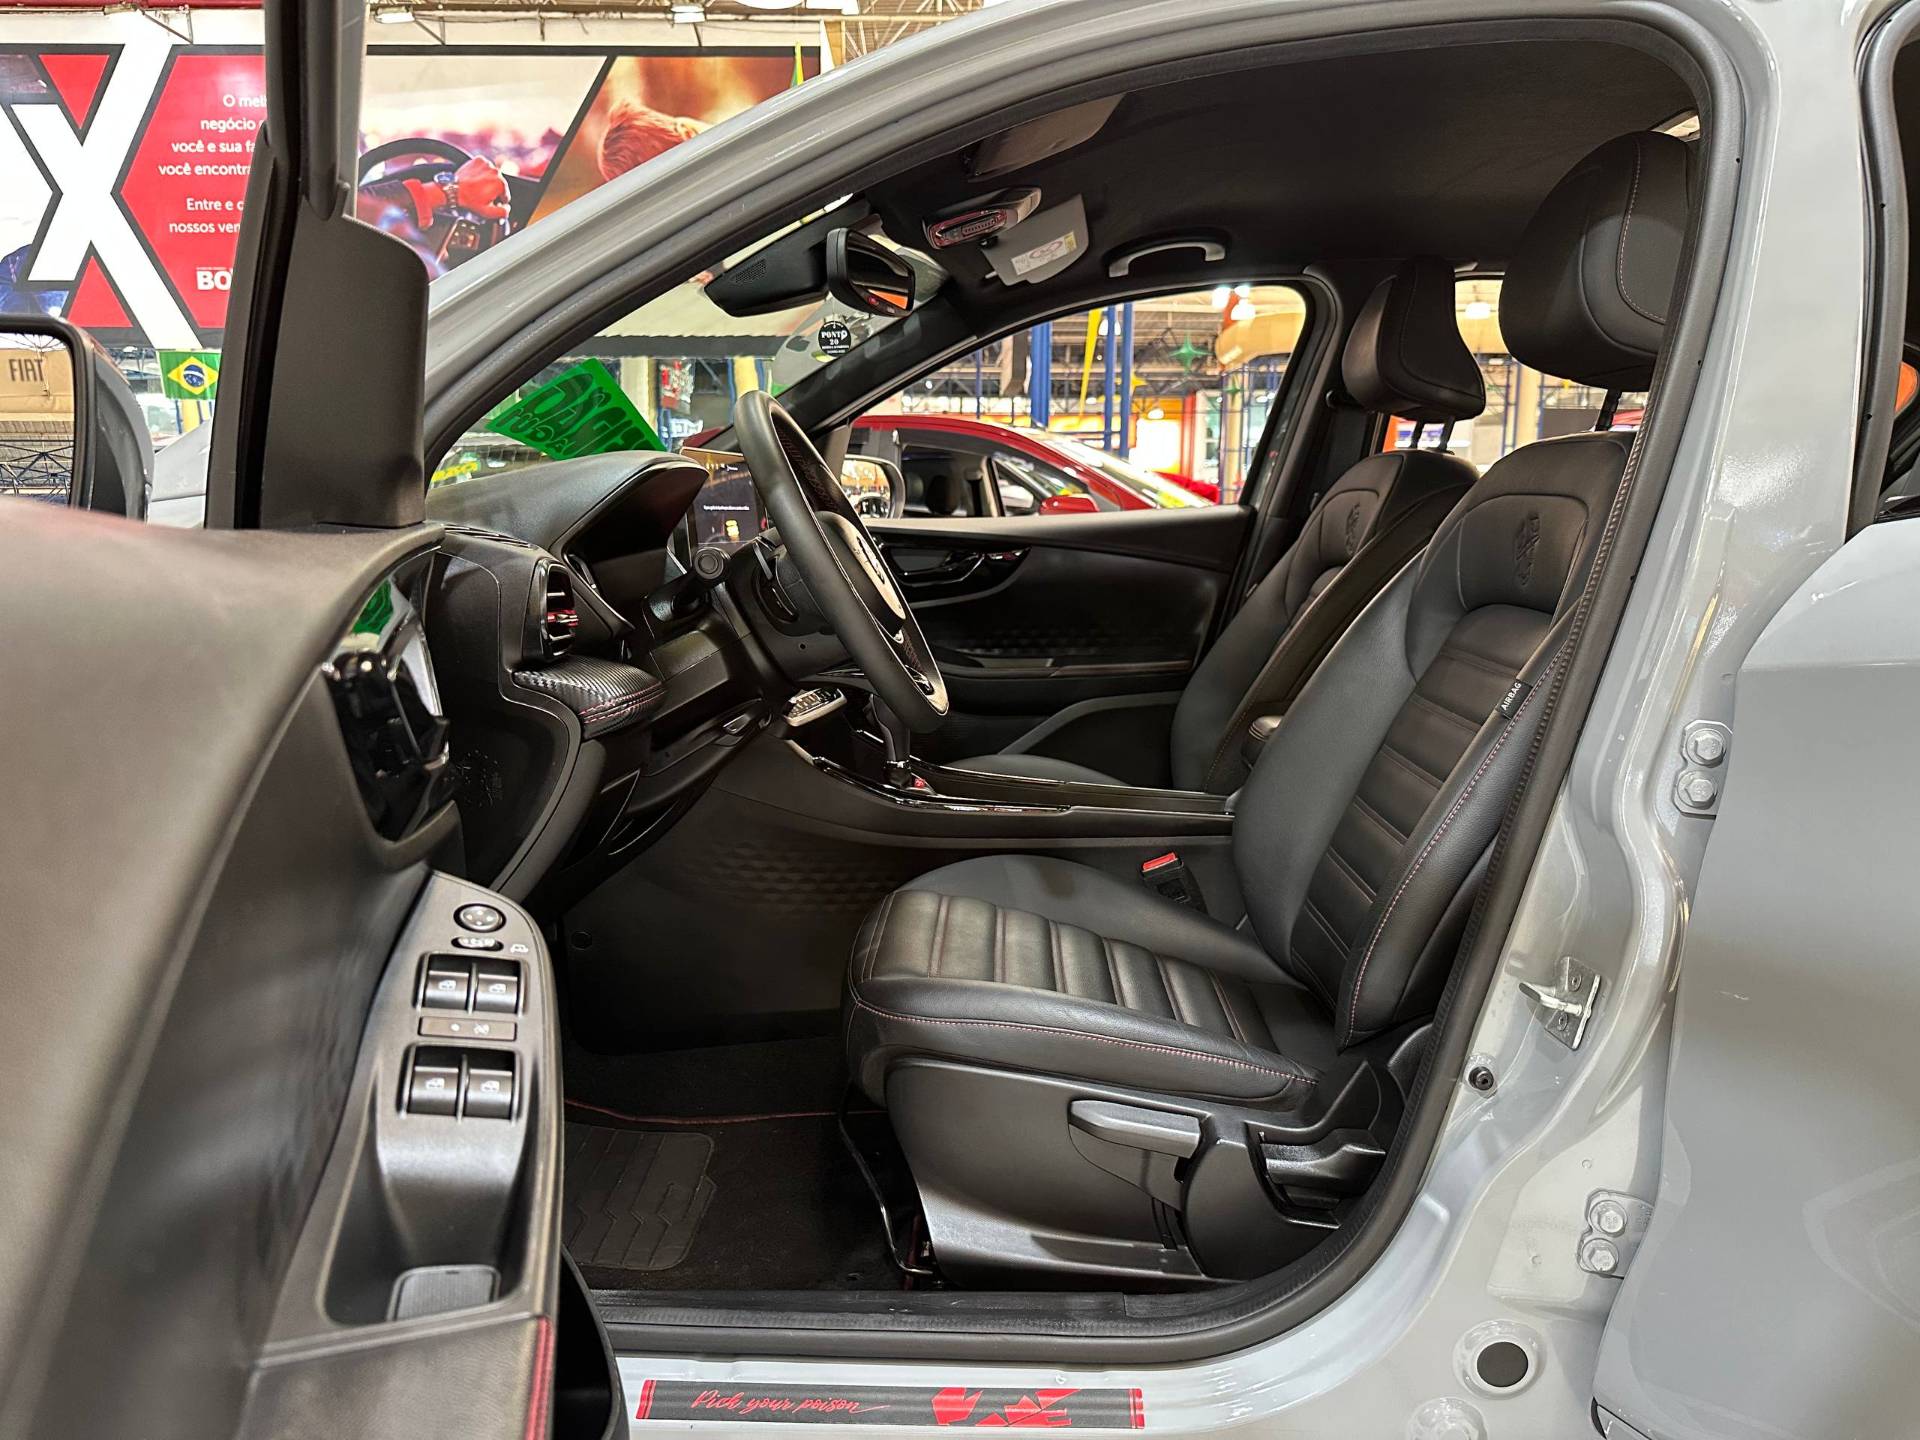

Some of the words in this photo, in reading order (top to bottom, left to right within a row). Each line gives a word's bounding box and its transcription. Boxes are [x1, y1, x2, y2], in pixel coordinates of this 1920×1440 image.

[223, 94, 235, 107] O
[200, 118, 256, 133] negócio
[171, 140, 204, 152] você
[207, 143, 216, 152] e
[219, 143, 242, 152] sua
[158, 162, 191, 175] você
[186, 198, 222, 210] Entre
[225, 201, 234, 210] e
[169, 223, 215, 233] nossos
[8, 358, 44, 381] FIAT
[1501, 682, 1521, 711] AIRBAG
[690, 1389, 745, 1409] Pick
[738, 1397, 794, 1414] your
[791, 1397, 890, 1414] poison
